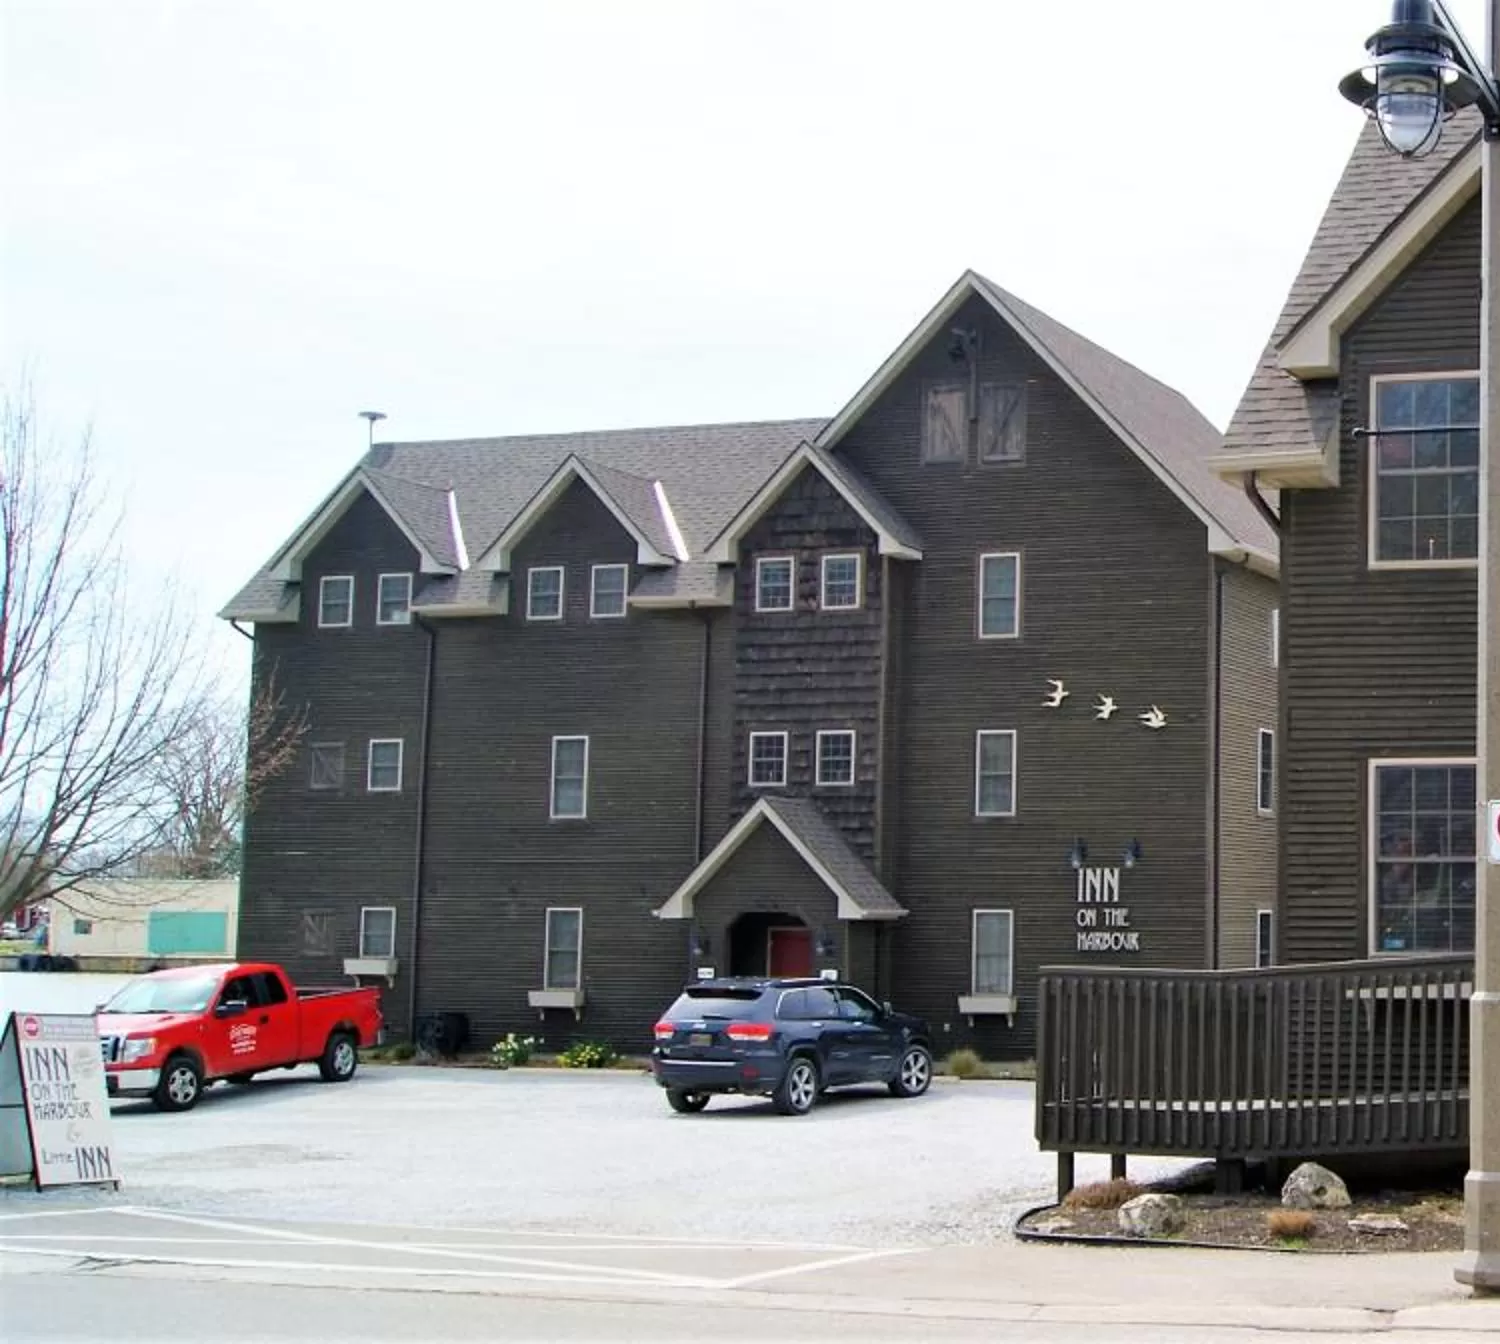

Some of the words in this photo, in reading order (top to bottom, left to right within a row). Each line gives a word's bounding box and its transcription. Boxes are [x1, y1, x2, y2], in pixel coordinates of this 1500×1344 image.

[1077, 867, 1120, 903] INN
[1077, 908, 1097, 927] ON
[1103, 908, 1130, 927] THE
[1077, 931, 1140, 951] HARBOUR
[26, 1047, 70, 1081] INN
[31, 1083, 51, 1101] ON
[53, 1083, 80, 1101] THE
[34, 1101, 93, 1121] HARBOUR
[75, 1146, 113, 1179] INN
